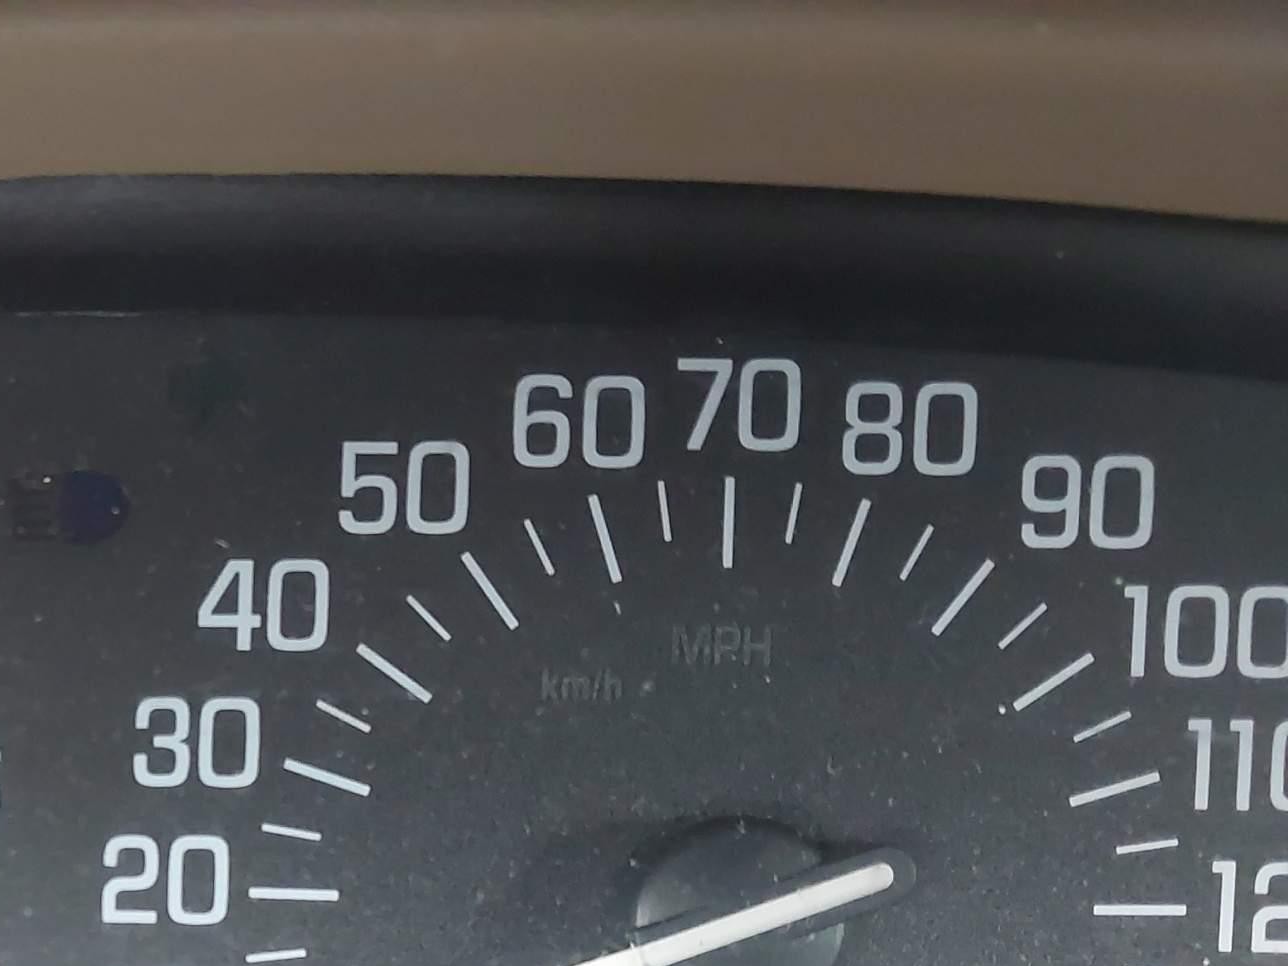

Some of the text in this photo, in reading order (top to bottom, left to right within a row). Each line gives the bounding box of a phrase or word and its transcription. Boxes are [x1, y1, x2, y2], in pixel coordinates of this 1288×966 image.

[512, 374, 646, 469] 60
[677, 357, 802, 452] 70
[842, 381, 978, 476] 80
[338, 440, 470, 535] 50
[1020, 454, 1155, 550] 90
[197, 558, 329, 652] 40
[671, 623, 772, 667] MPH
[1124, 584, 1288, 679] 100
[133, 696, 260, 789] 30
[101, 834, 229, 926] 20
